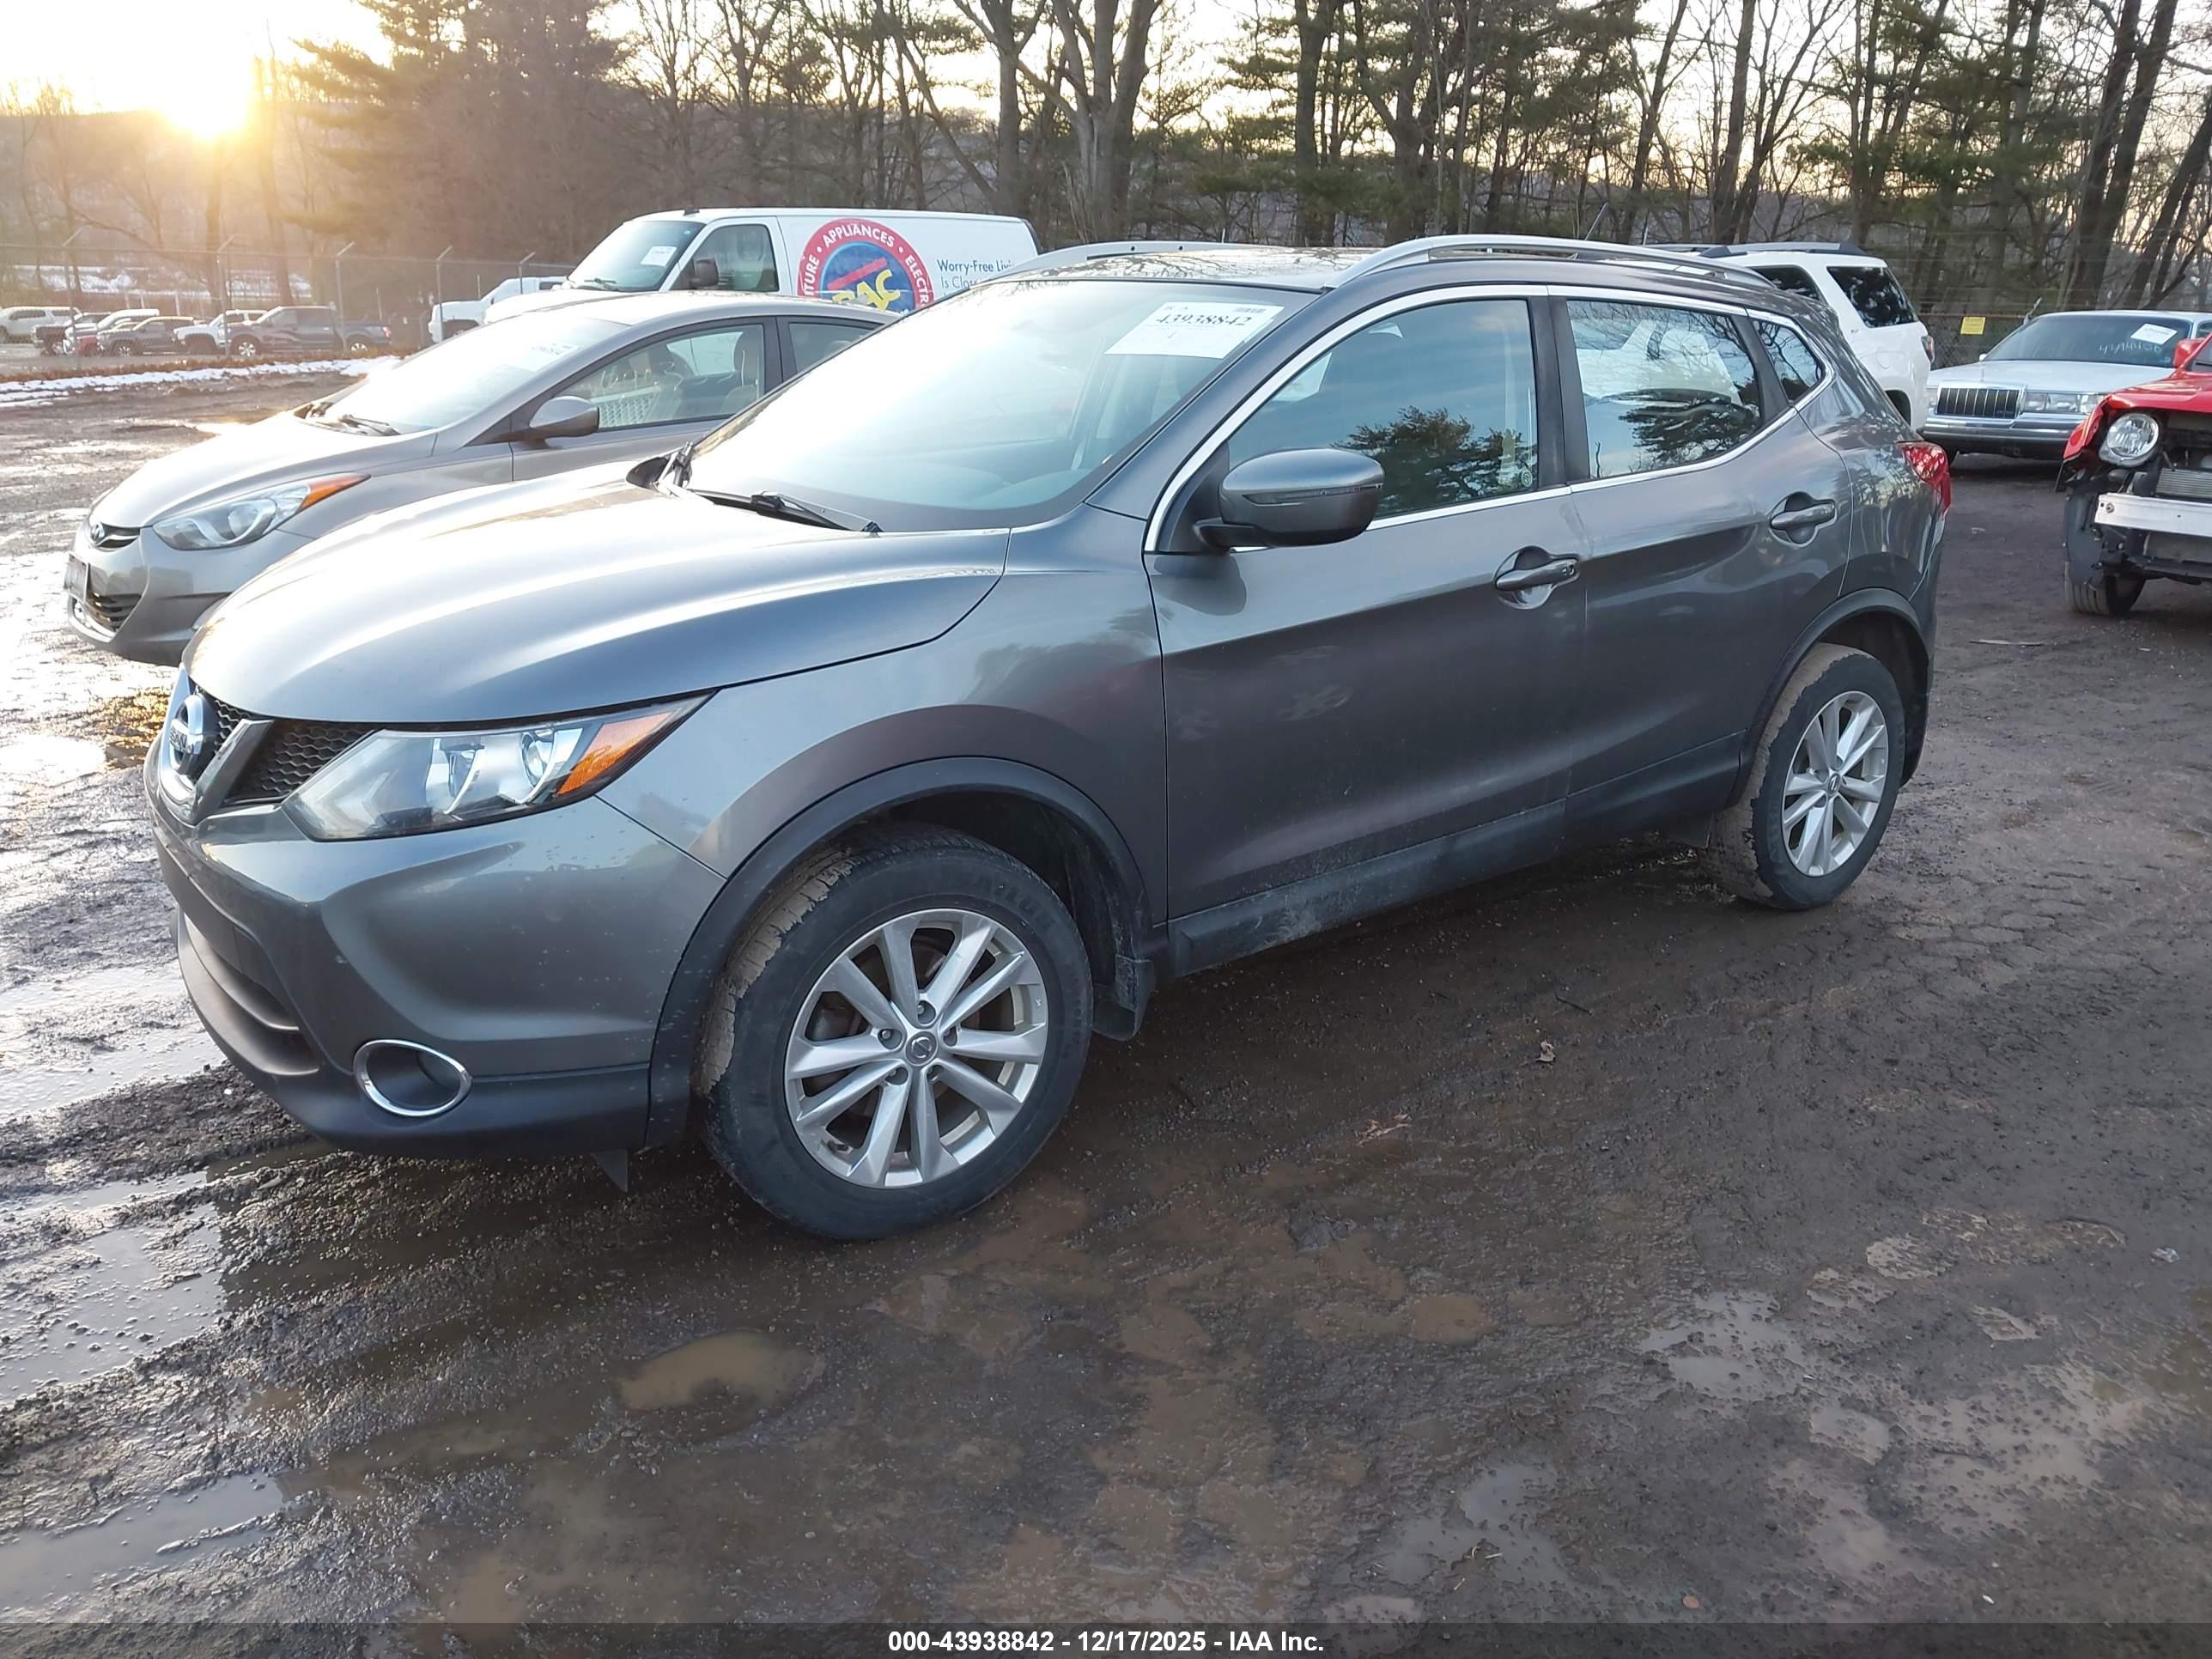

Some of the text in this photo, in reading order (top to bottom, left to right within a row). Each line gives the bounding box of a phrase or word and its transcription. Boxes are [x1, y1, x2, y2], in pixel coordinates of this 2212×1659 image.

[822, 223, 896, 248] APPLIANCES
[904, 254, 930, 306] ELECTR
[936, 259, 994, 275] Worry-Free
[940, 276, 950, 289] Is
